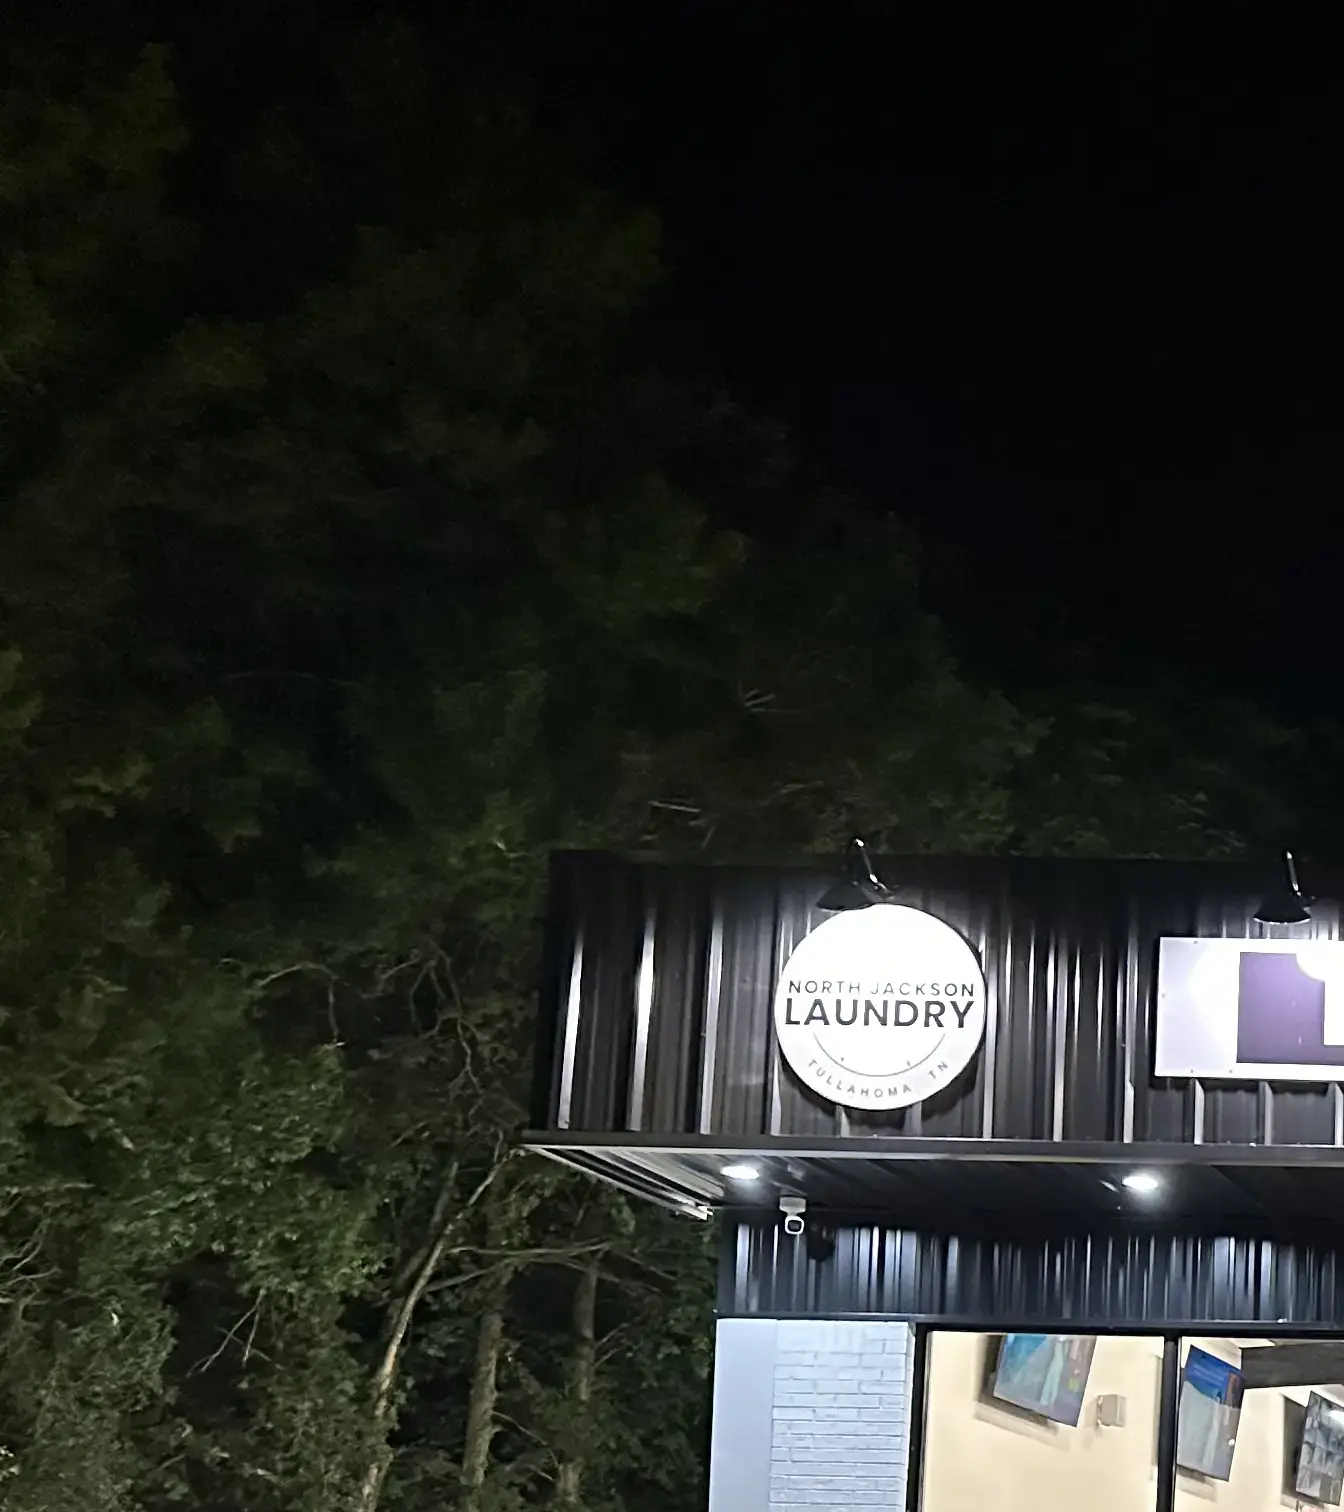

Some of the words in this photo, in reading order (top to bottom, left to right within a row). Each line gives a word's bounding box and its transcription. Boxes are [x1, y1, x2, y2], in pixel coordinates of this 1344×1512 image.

[788, 980, 861, 995] NORTH
[871, 982, 974, 997] JACKSON
[785, 998, 975, 1029] LAUNDRY
[808, 1059, 912, 1098] TULLAHOMA
[928, 1061, 949, 1080] TN
